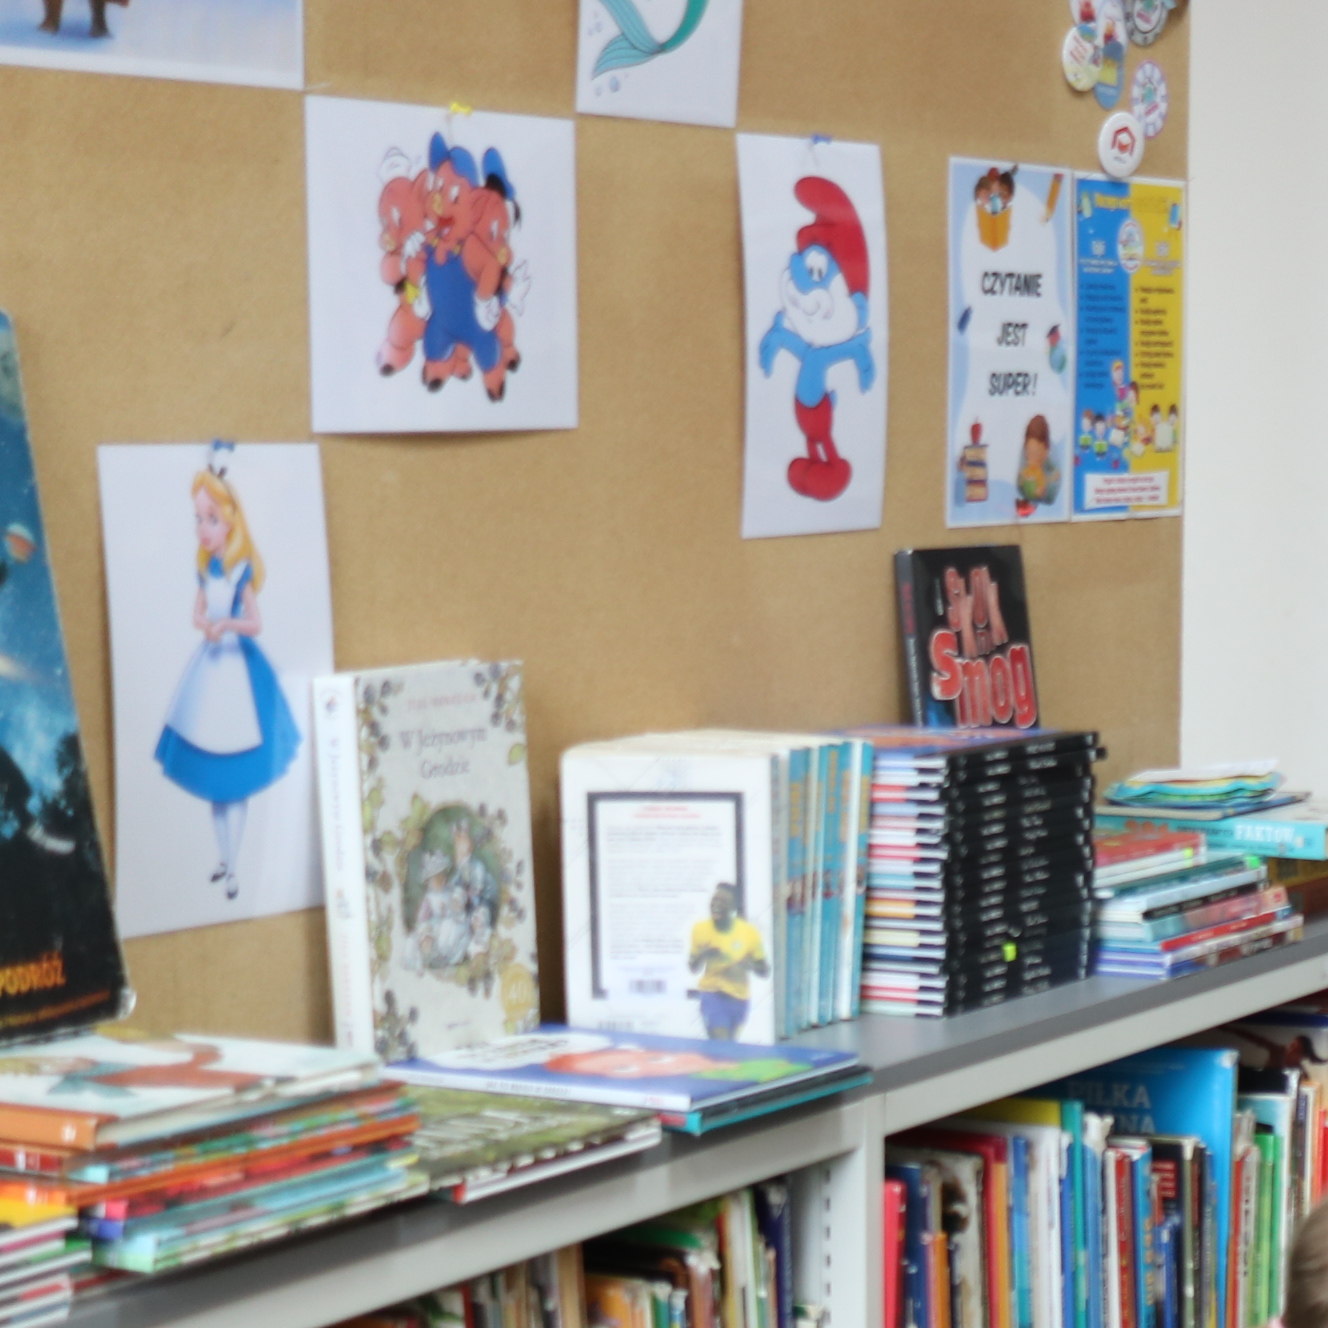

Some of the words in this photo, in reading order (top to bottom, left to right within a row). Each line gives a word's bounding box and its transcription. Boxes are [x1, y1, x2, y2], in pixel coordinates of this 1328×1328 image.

[981, 271, 1042, 297] CZYTANIE
[997, 322, 1028, 347] JEST
[930, 628, 1037, 729] Smog
